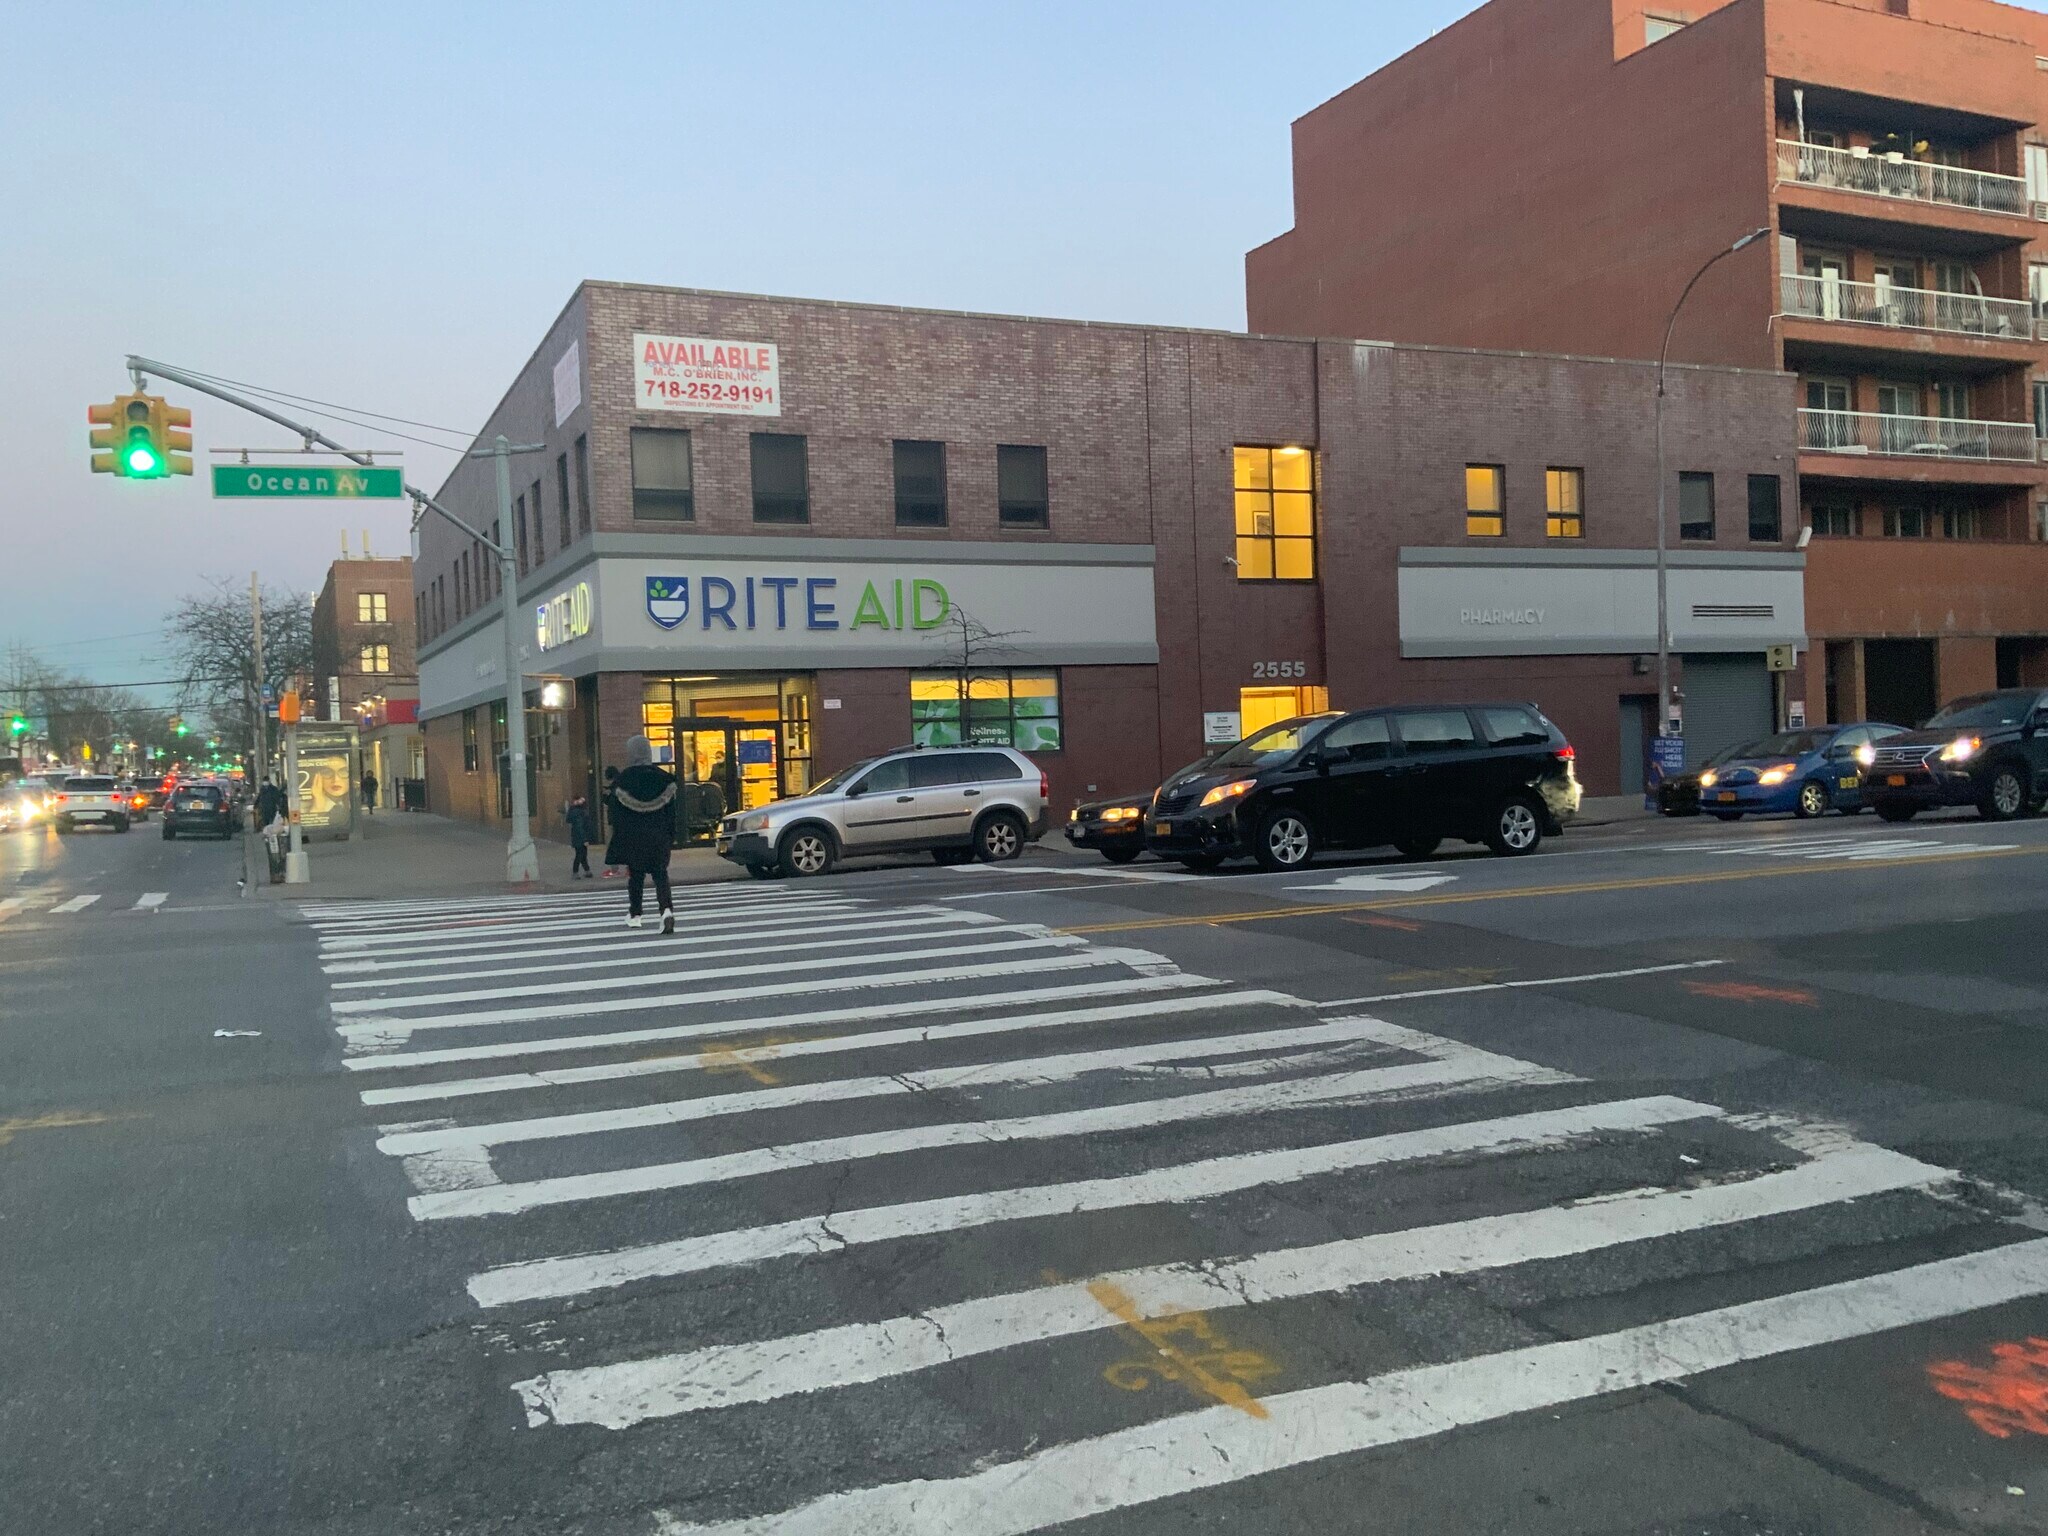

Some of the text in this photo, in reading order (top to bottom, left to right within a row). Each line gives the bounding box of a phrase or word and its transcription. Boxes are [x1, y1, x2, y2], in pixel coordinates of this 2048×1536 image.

[644, 341, 770, 370] AVAILABLE
[653, 367, 680, 377] M.C.
[644, 380, 773, 403] 718-252-9191
[247, 473, 369, 492] Ocean Av
[700, 576, 951, 630] RITE AID
[544, 582, 590, 650] RITE AID
[1460, 608, 1545, 625] PHARMACY
[1252, 661, 1306, 678] 2555
